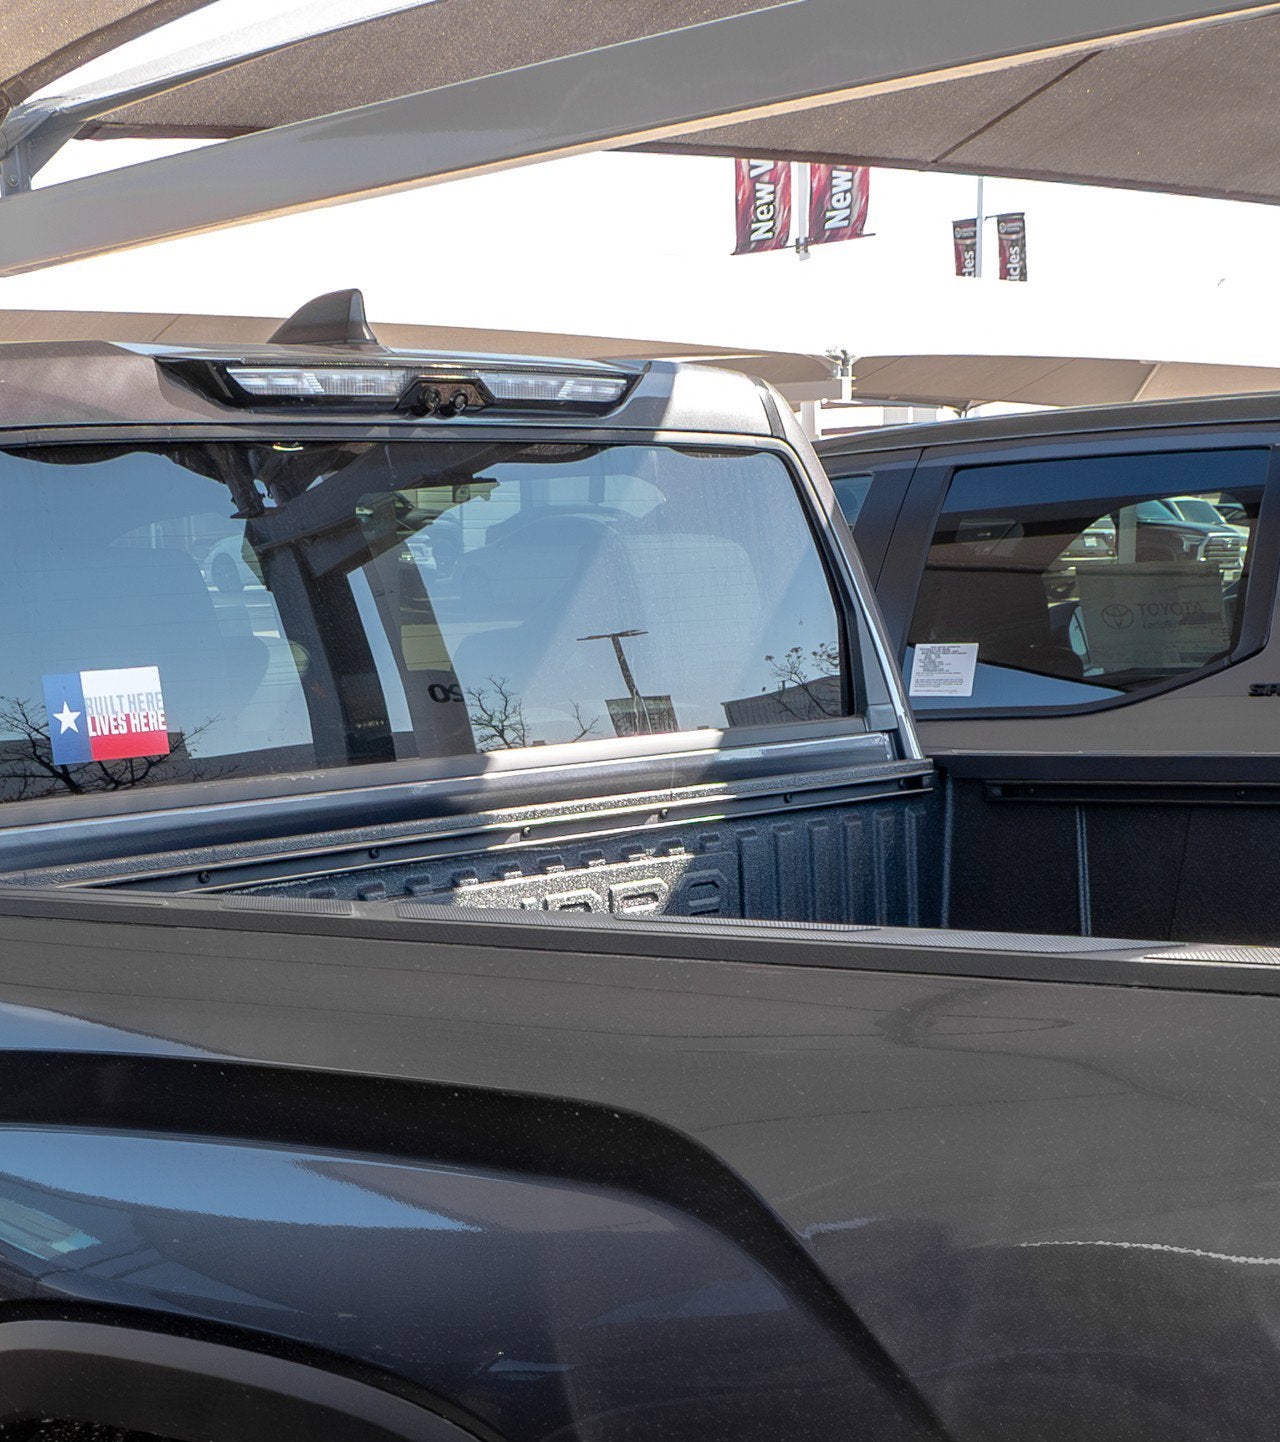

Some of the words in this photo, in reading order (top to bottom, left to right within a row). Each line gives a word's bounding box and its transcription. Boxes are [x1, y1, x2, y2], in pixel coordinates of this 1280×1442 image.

[750, 181, 775, 241] New
[823, 169, 852, 230] New
[1137, 602, 1204, 617] TOYOTA
[84, 694, 124, 717] BUILT
[127, 691, 164, 713] HERE
[87, 713, 128, 737] LIVES
[129, 710, 167, 733] HERE
